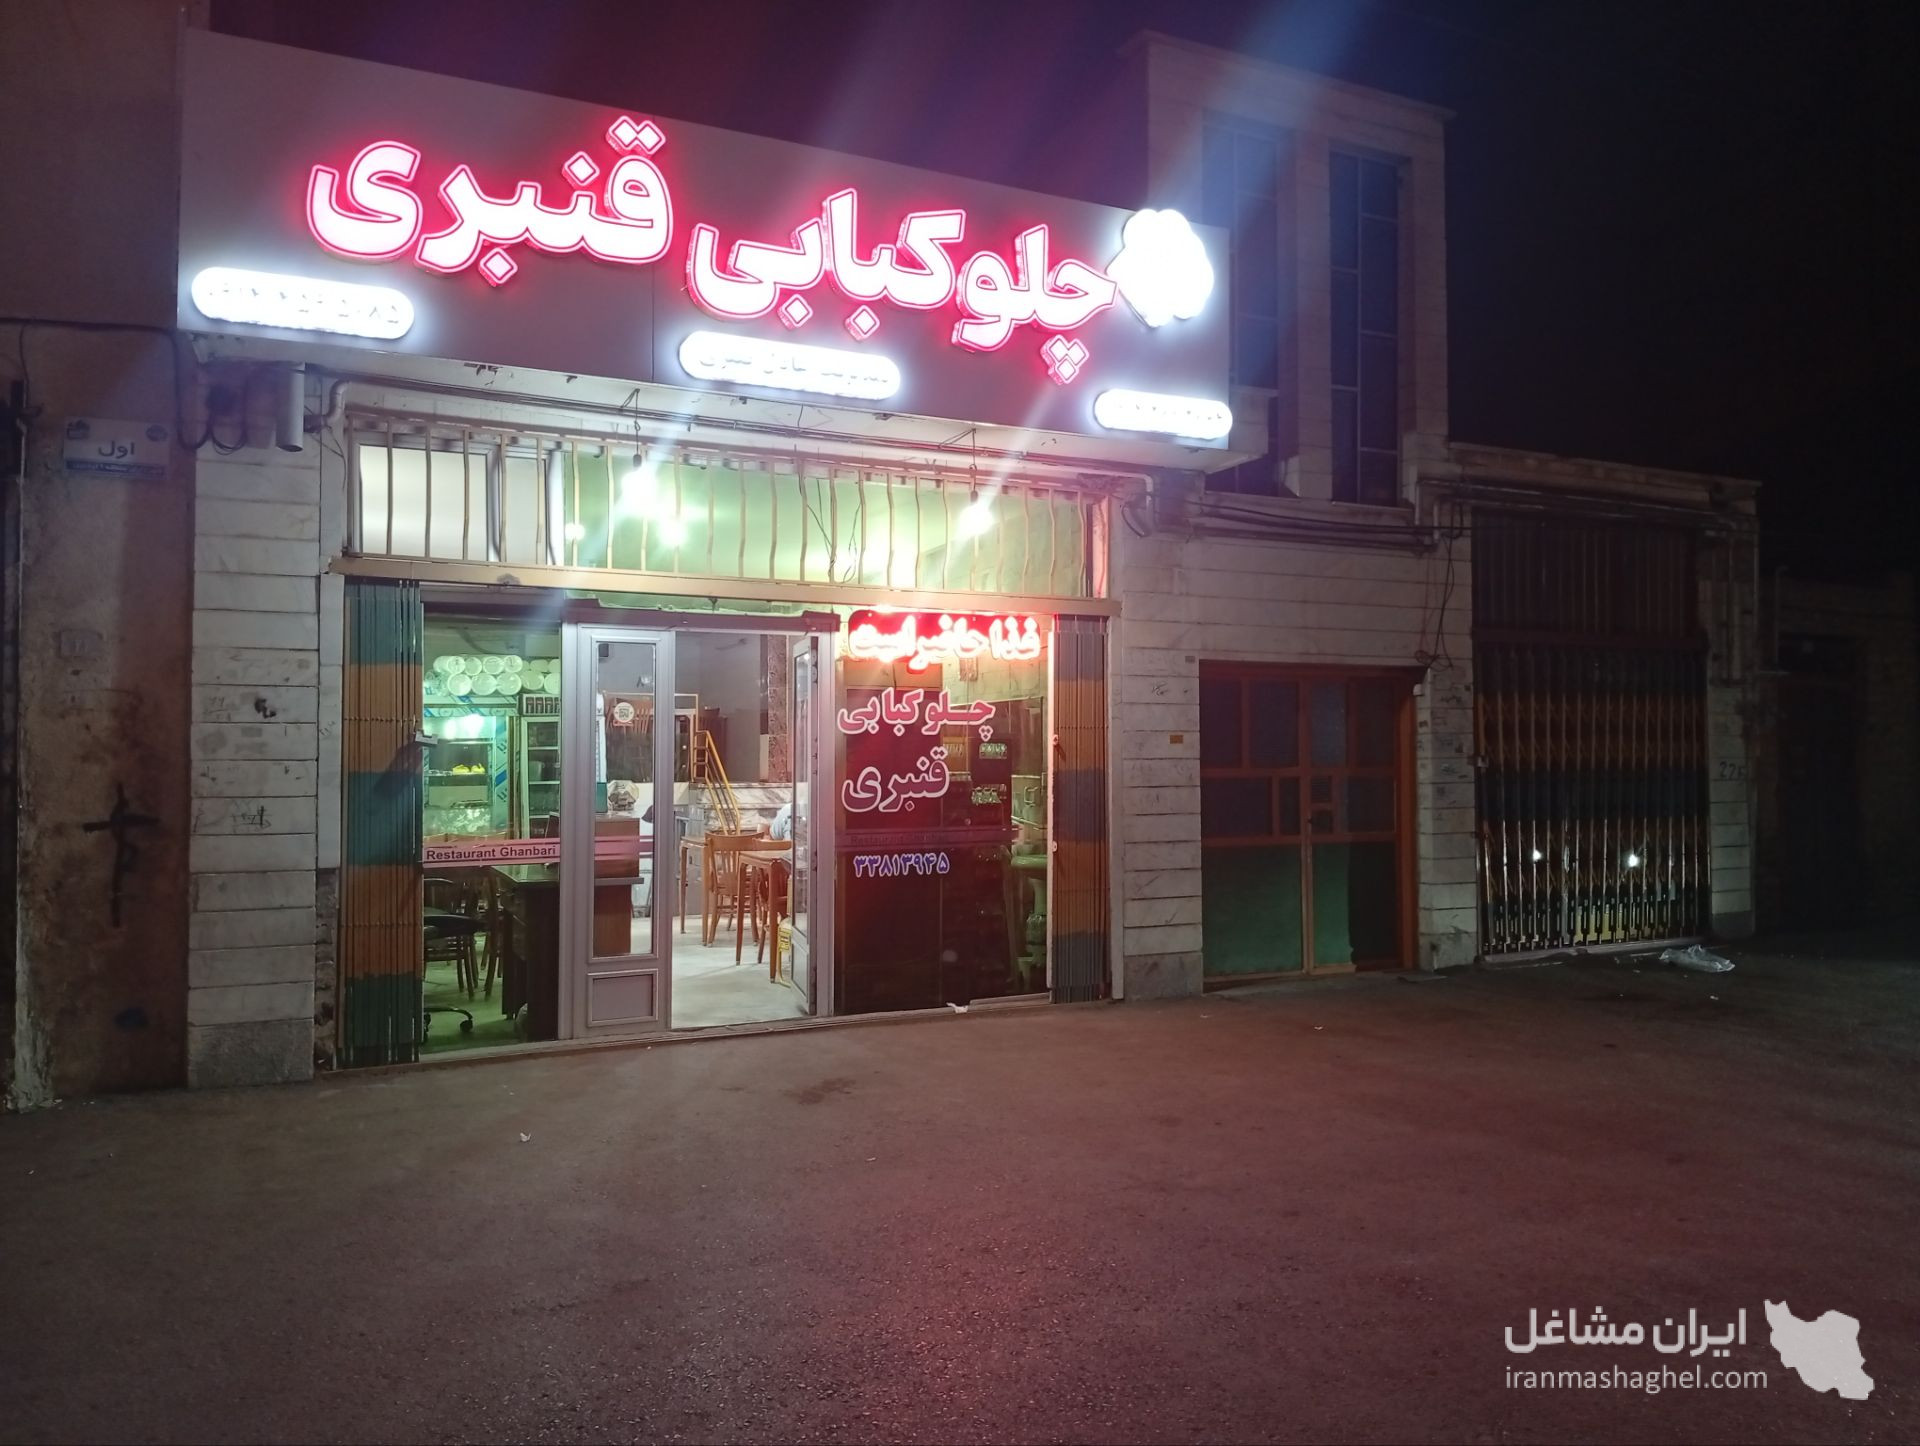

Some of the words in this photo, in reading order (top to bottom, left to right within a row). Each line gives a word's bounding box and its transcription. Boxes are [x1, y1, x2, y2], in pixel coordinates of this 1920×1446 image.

[305, 115, 674, 287] قنبری
[98, 440, 135, 459] اول
[850, 615, 917, 662] است
[908, 614, 989, 670] حاضر
[989, 616, 1041, 660] غذا
[841, 746, 950, 813] قنبری
[426, 848, 496, 860] Restaurant
[500, 845, 556, 857] Ghanbari
[853, 851, 950, 878] ۳۳۸۱۳۹۴۵
